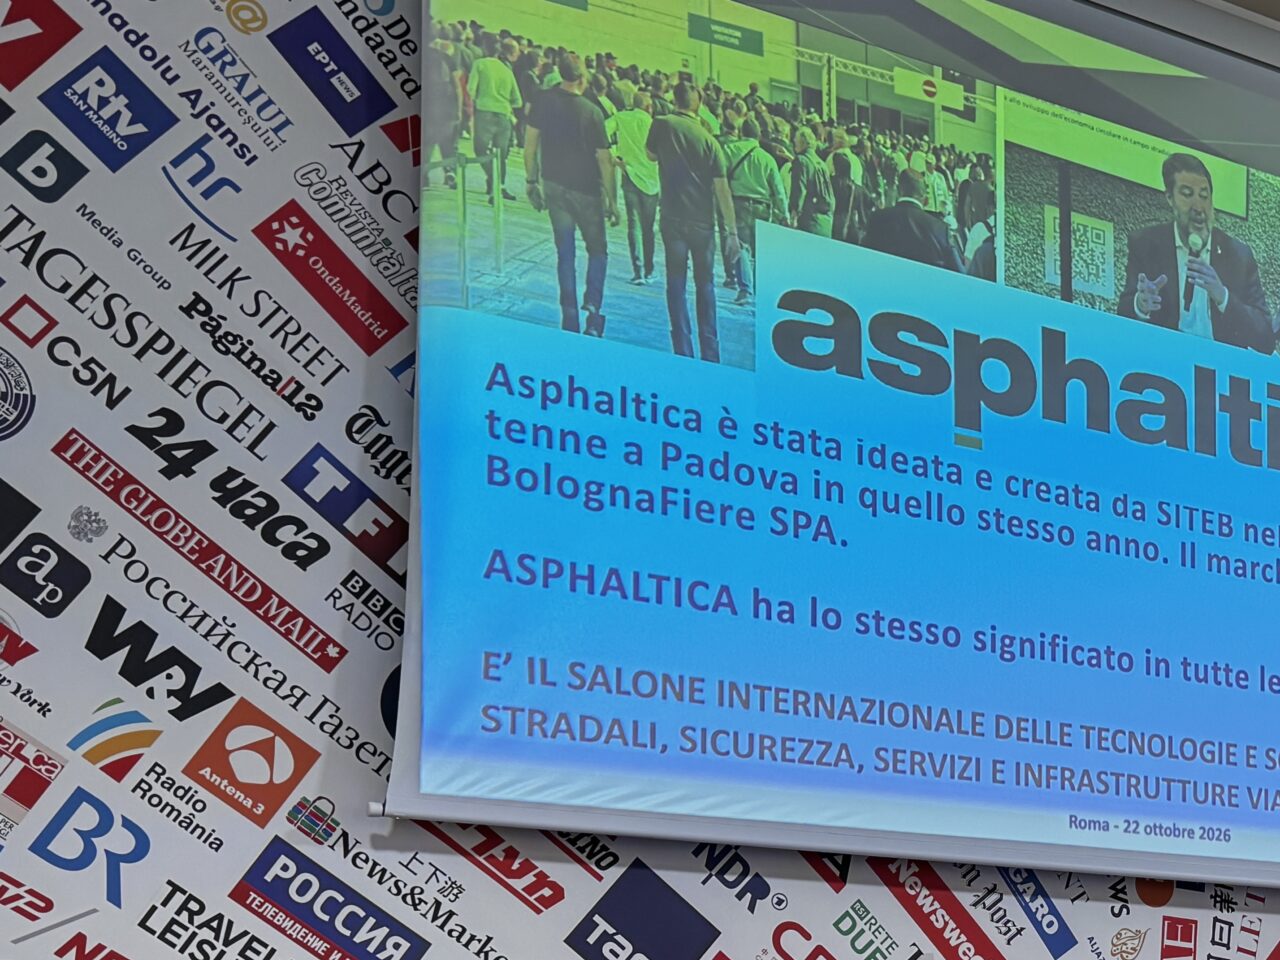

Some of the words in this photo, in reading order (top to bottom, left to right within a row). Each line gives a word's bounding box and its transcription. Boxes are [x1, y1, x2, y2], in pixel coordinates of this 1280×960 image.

[194, 26, 295, 145] GRAIUL
[329, 139, 419, 223] ABC
[76, 203, 123, 249] Media
[127, 249, 172, 292] Group
[168, 222, 253, 299] MILK
[239, 288, 350, 388] STREET
[308, 254, 389, 341] OndaMadrid
[46, 335, 132, 411] C5N
[485, 362, 702, 433] Asphaltica
[719, 406, 738, 440] è
[753, 421, 842, 461] stata
[856, 438, 962, 486] ideata
[976, 469, 993, 491] e
[1005, 473, 1100, 513] creata
[1112, 494, 1147, 523] da
[1157, 501, 1233, 538] SITEB
[485, 409, 607, 460] tenne
[623, 441, 643, 467] a
[661, 441, 798, 496] Padova
[814, 469, 844, 504] in
[859, 486, 965, 526] quello
[977, 507, 1075, 547] stesso
[1086, 530, 1169, 565] anno.
[1180, 542, 1197, 569] Il
[59, 431, 123, 489] THE
[119, 480, 209, 560] GLOBE
[200, 550, 263, 606] AND
[256, 590, 326, 660] MAIL
[486, 454, 756, 531] BolognaFiere
[769, 506, 849, 548] SPA.
[100, 533, 311, 711] Российская
[483, 549, 739, 616] ASPHALTICA
[752, 587, 795, 625] ha
[810, 596, 842, 631] lo
[855, 609, 961, 648] stesso
[972, 625, 1135, 673] significato
[1145, 648, 1171, 679] in
[1181, 656, 1250, 690] tutte
[480, 705, 668, 755] STRADALI,
[679, 726, 864, 774] SICUREZZA,
[873, 747, 981, 782] SERVIZI
[991, 759, 1005, 785] E
[1015, 762, 1239, 808] INFRASTRUTTURE
[527, 656, 557, 687] IL
[567, 661, 705, 705] SALONE
[716, 679, 985, 737] INTERNAZIONALE
[994, 713, 1073, 748] DELLE
[1080, 724, 1238, 767] TECNOLOGIE
[1245, 746, 1257, 769] E
[131, 778, 224, 853] România
[145, 761, 206, 813] Radio
[199, 767, 255, 811] Antena
[252, 803, 265, 815] 3
[1069, 815, 1110, 832] Roma
[1123, 820, 1140, 834] 22
[1144, 822, 1195, 840] ottobre
[1199, 825, 1232, 843] 2026
[28, 785, 151, 909] BR
[245, 892, 331, 953] ТЕЛЕВИДЕНИЕ
